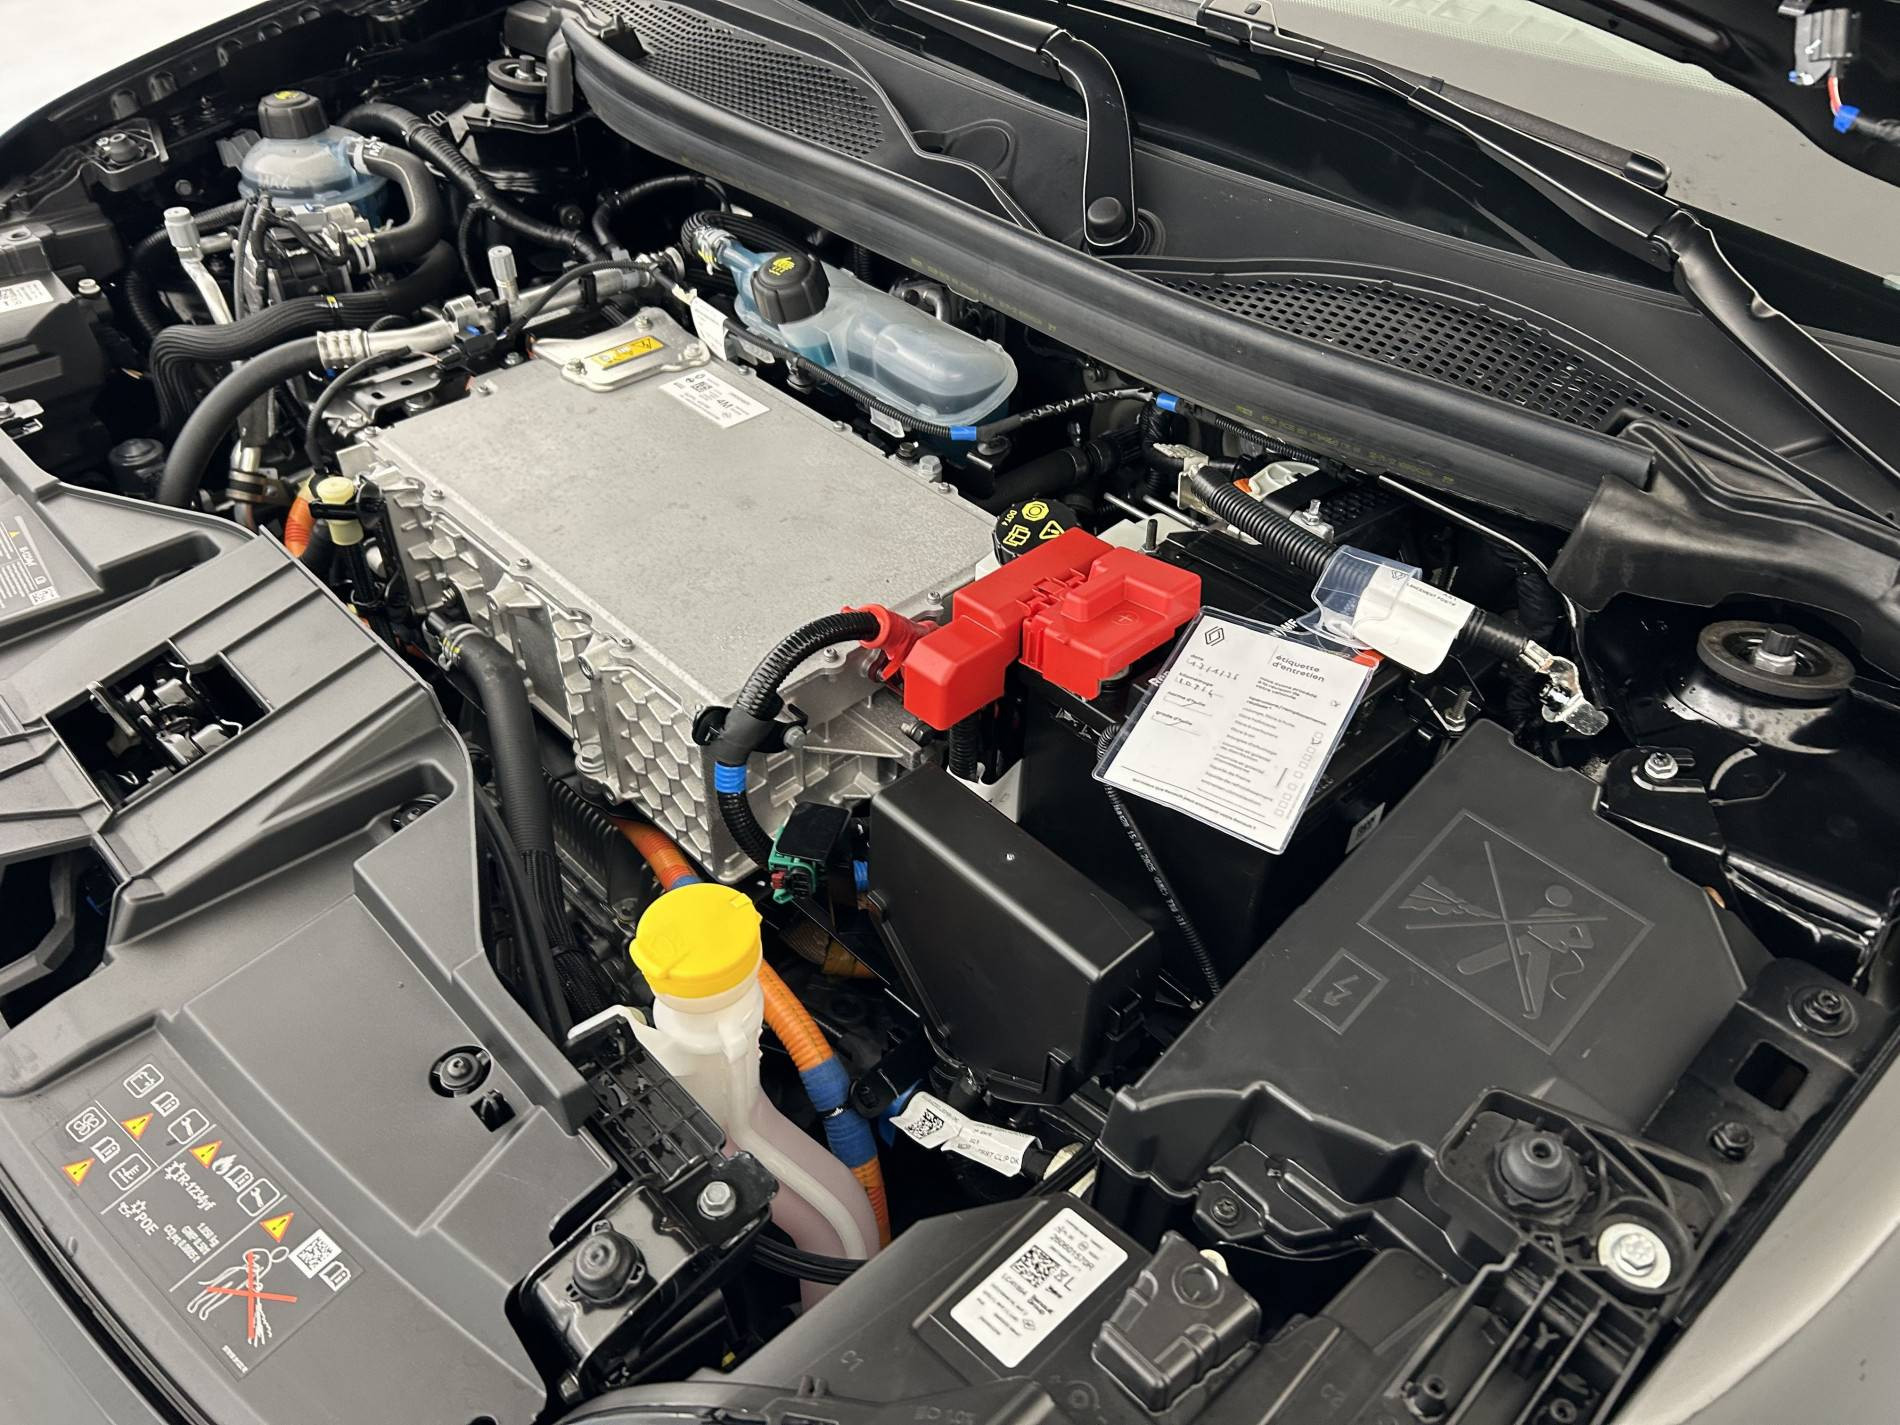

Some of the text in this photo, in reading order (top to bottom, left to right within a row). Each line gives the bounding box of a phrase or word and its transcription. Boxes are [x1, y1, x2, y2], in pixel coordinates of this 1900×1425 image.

[1005, 510, 1018, 522] DOT
[1272, 660, 1325, 683] d'entretien
[1276, 654, 1320, 673] étiquette
[178, 1174, 216, 1211] R-1234yf
[135, 1212, 158, 1237] POE
